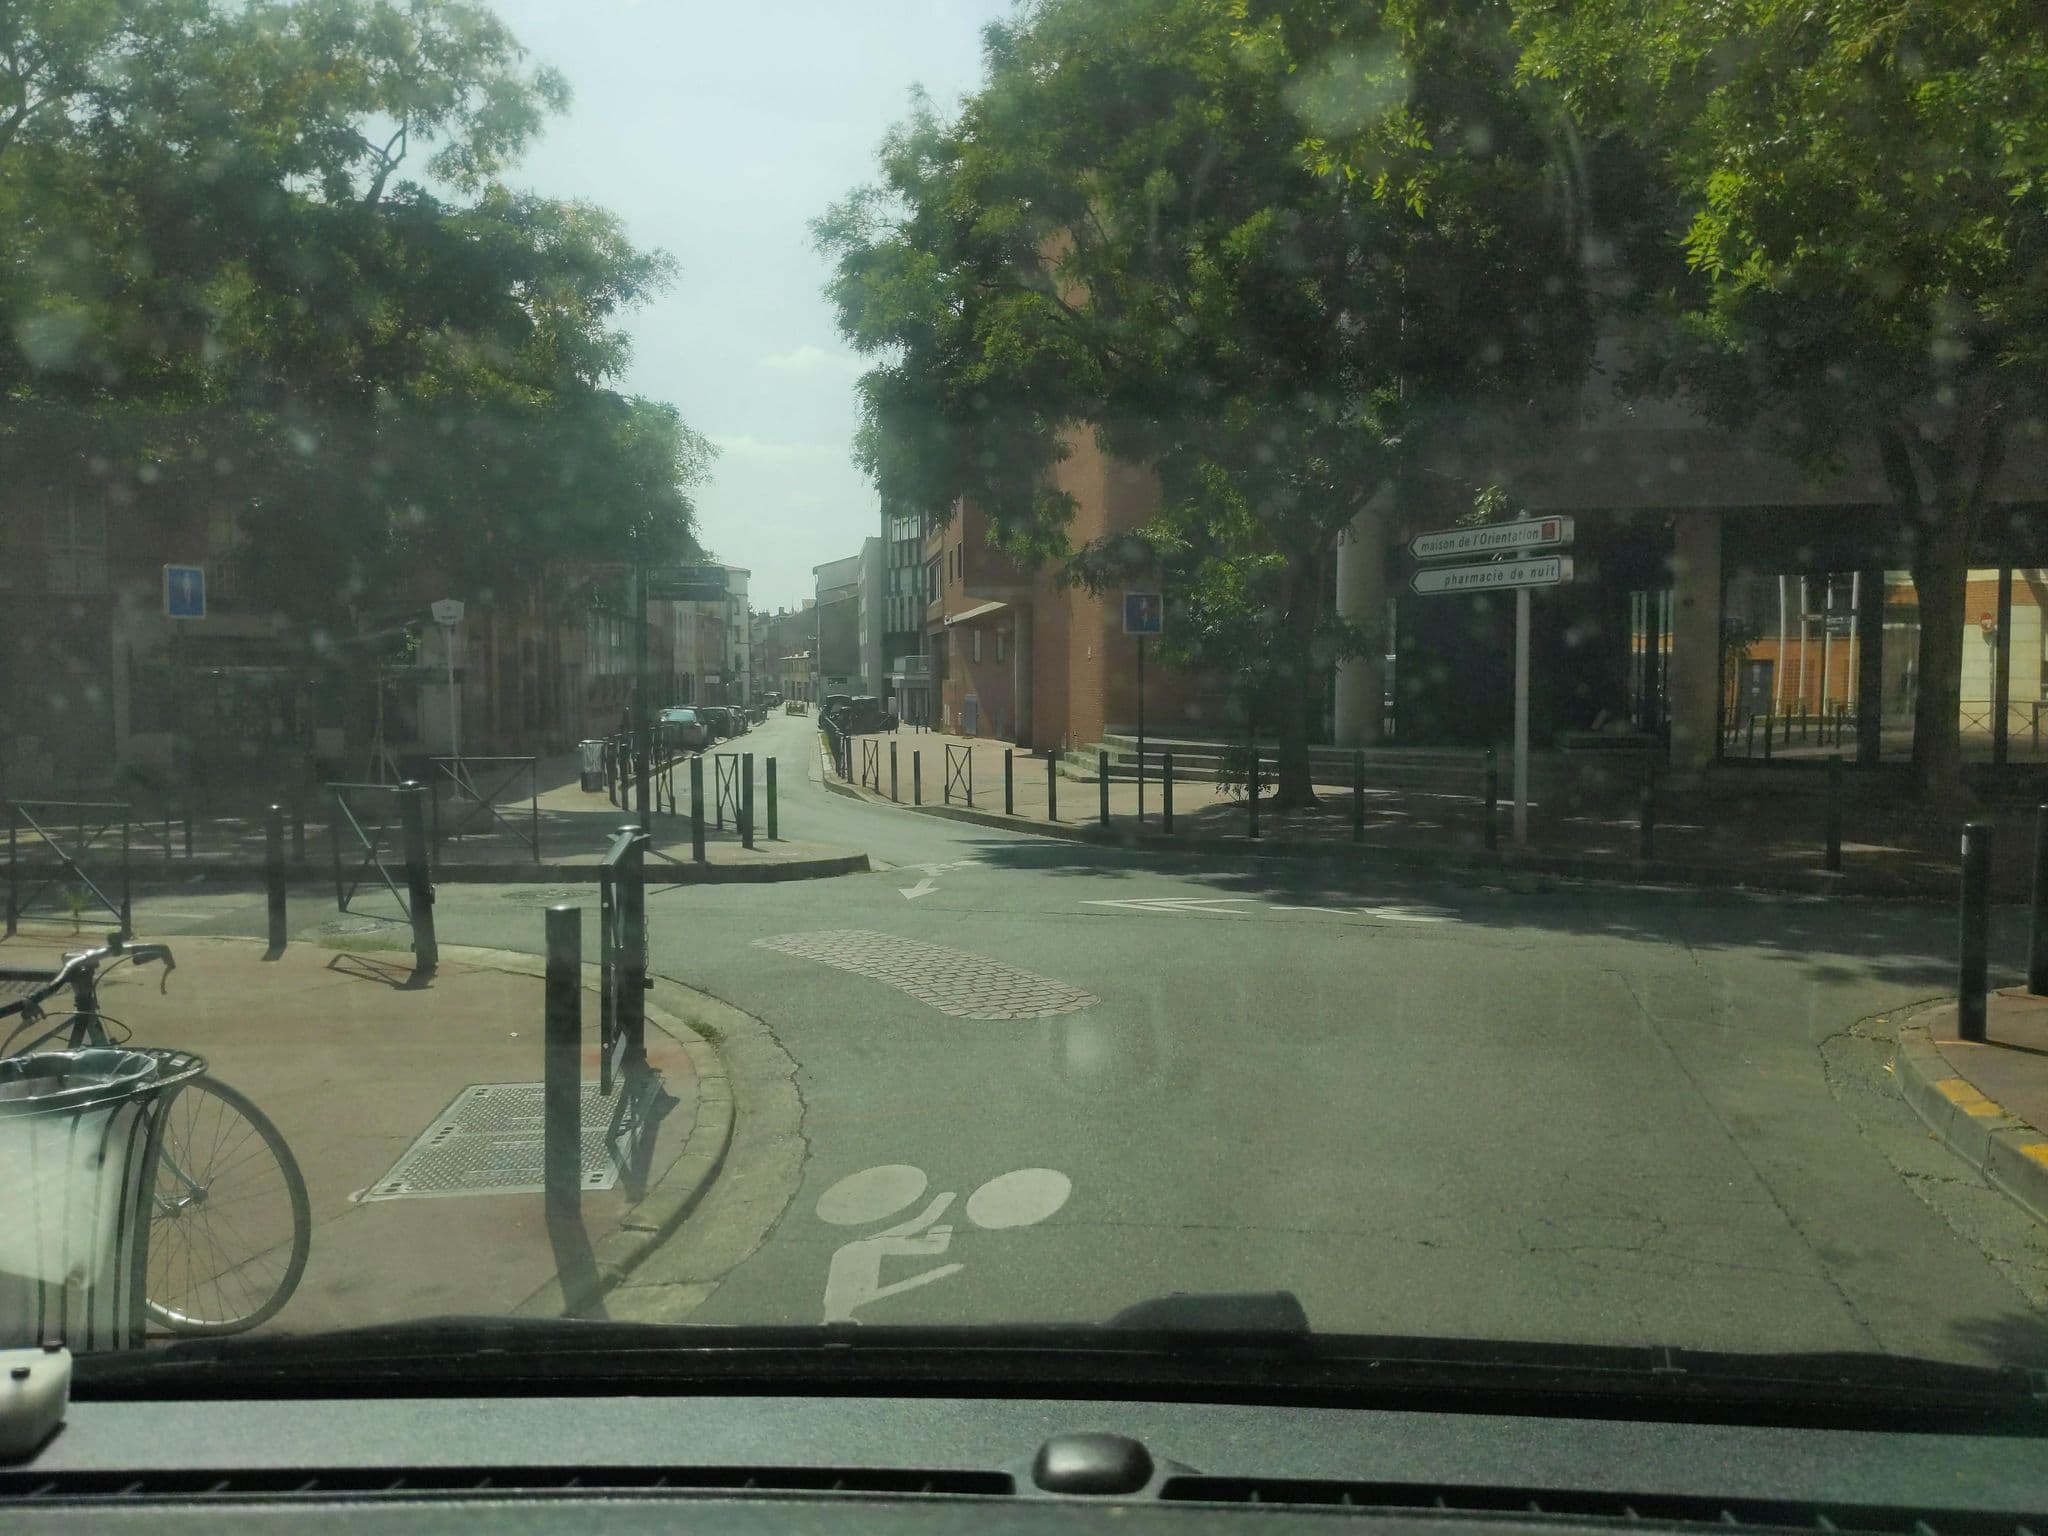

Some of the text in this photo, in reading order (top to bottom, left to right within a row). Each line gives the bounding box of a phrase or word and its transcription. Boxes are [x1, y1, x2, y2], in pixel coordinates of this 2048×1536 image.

[1421, 539, 1456, 552] maison
[1459, 536, 1470, 548] de
[1445, 565, 1556, 587] pharmacie de nuit
